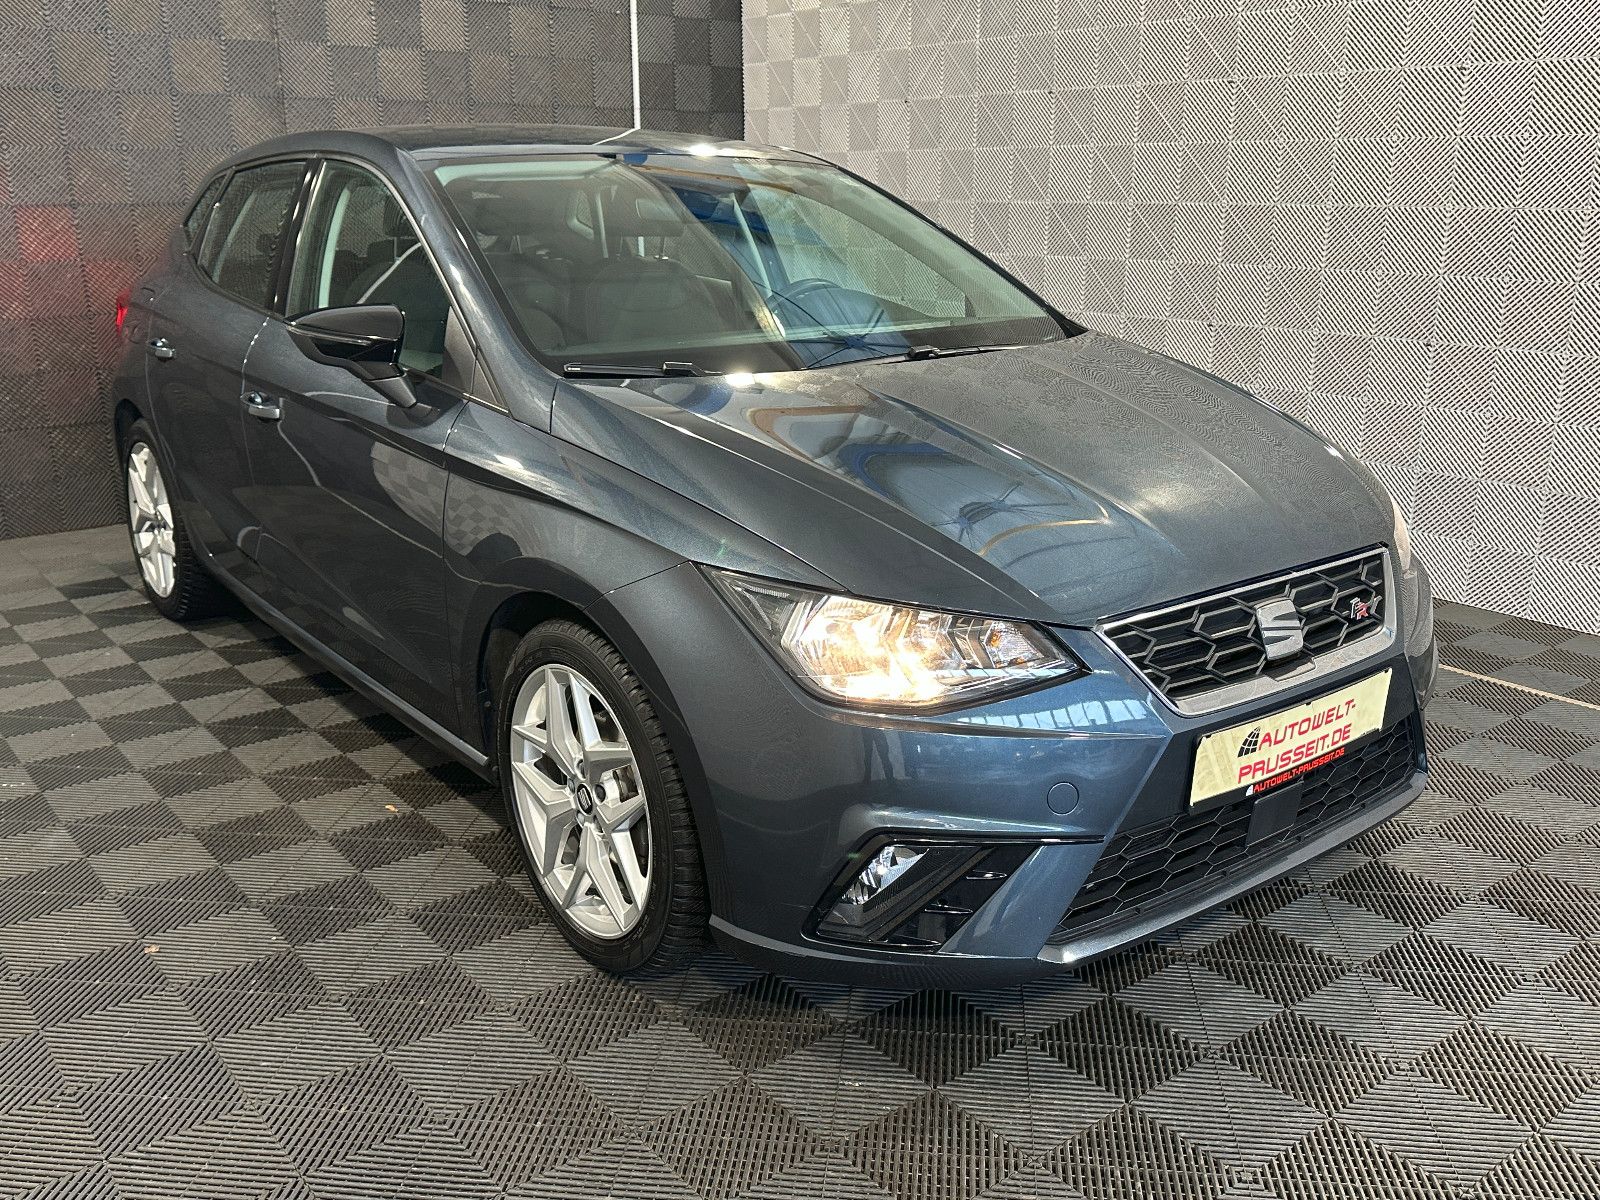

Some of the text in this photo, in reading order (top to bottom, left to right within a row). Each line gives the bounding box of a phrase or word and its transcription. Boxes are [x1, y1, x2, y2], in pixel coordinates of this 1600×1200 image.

[1258, 699, 1356, 751] AUTOWELT-
[1237, 723, 1352, 784] PRUSSEIT.DE
[1253, 748, 1345, 793] AUTOWELT-PRUSSEIT.DE
